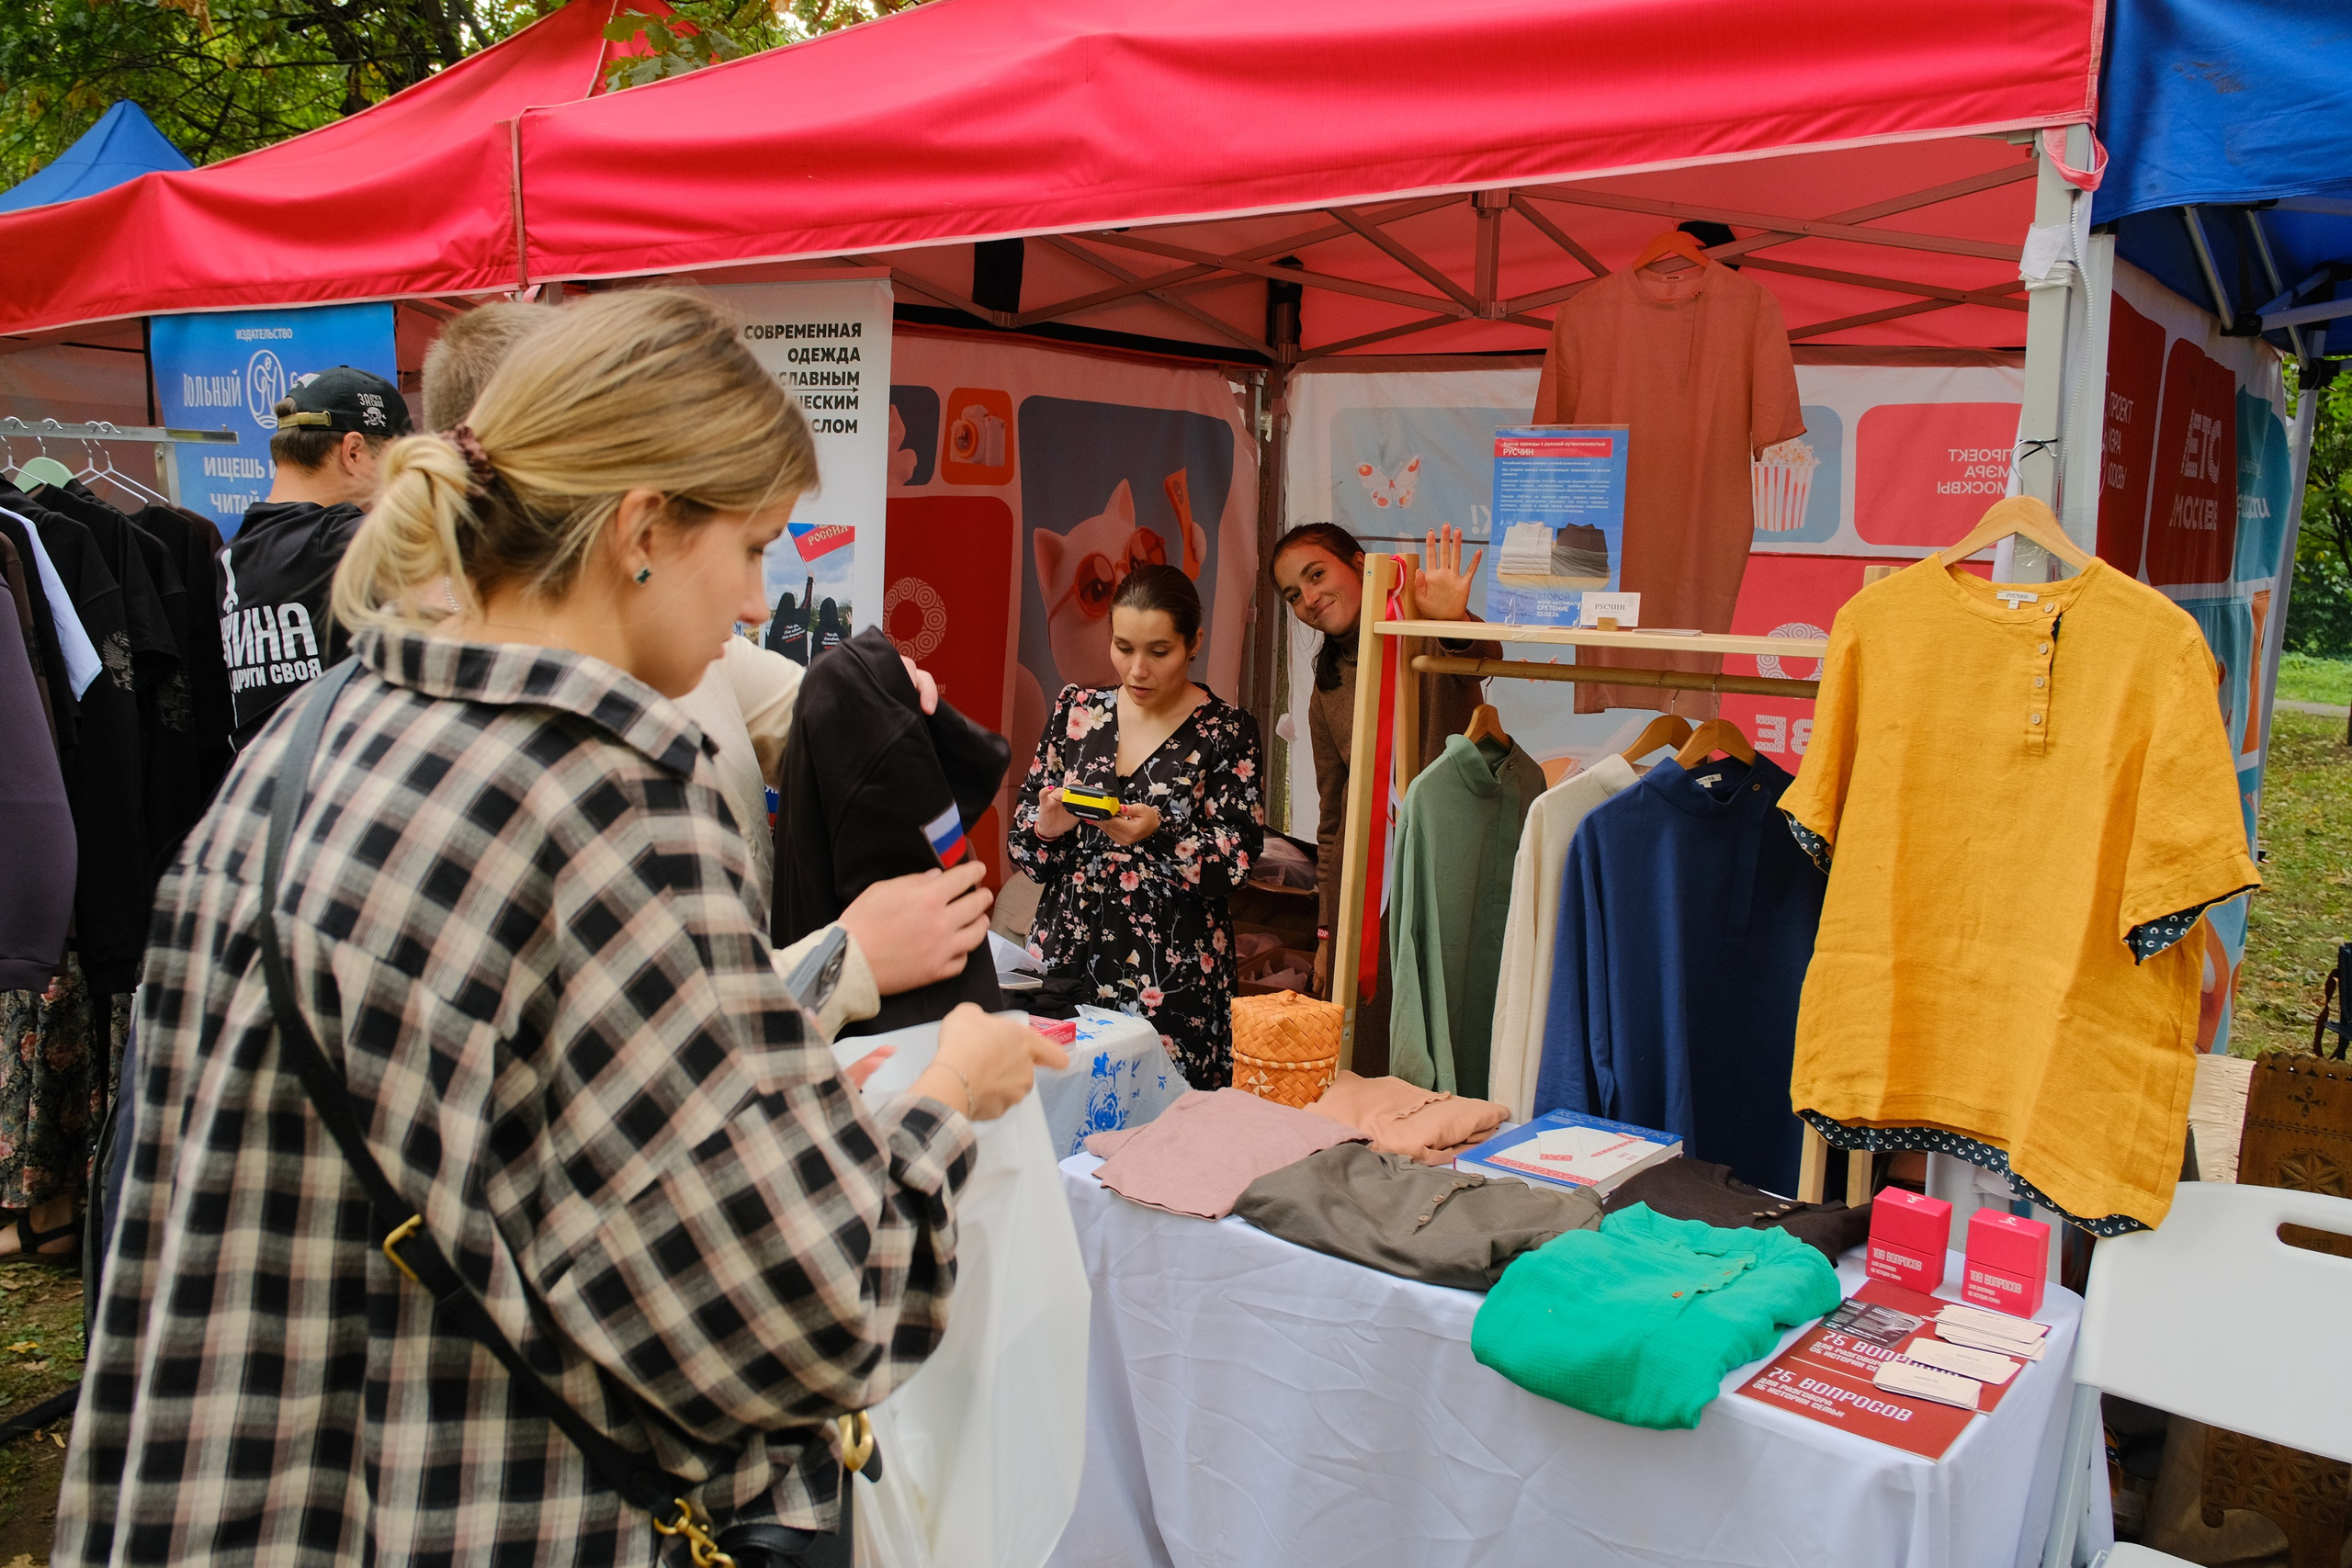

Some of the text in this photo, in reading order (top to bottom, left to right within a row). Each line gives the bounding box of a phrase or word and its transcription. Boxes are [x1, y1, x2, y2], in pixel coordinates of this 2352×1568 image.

[235, 328, 293, 342] ИЗДАТЕЛЬСТВО
[743, 322, 862, 340] СОВРЕМЕННАЯ
[787, 347, 861, 365] ОДЕЖДА
[2109, 391, 2134, 423] ПРОЕКТ
[809, 419, 858, 434] СЛОМ
[2180, 409, 2222, 484] ЕТО
[204, 457, 266, 483] ИЩЕШЬ
[210, 490, 261, 514] ЧИТАЙ
[220, 602, 319, 668] ИНА
[232, 658, 322, 694] ДРУГИ СВОЯ
[1556, 1110, 1676, 1143] КОСОВОРОТКА
[1886, 1251, 1922, 1271] ВОПРОСОВ
[1984, 1274, 2022, 1294] ВОПРОСОВ
[1813, 1340, 1836, 1351] ДЛЯ
[1822, 1331, 1849, 1347] 75
[1823, 1350, 1865, 1368] ИСТОРИИ
[1752, 1382, 1845, 1418] ОБ ИСТОРИИ СЕМЬИ
[1756, 1377, 1833, 1407] ДЛЯ РАЗГОВОРА
[1768, 1366, 1796, 1383] 75
[1798, 1378, 1913, 1422] ВОПРОСОВ
